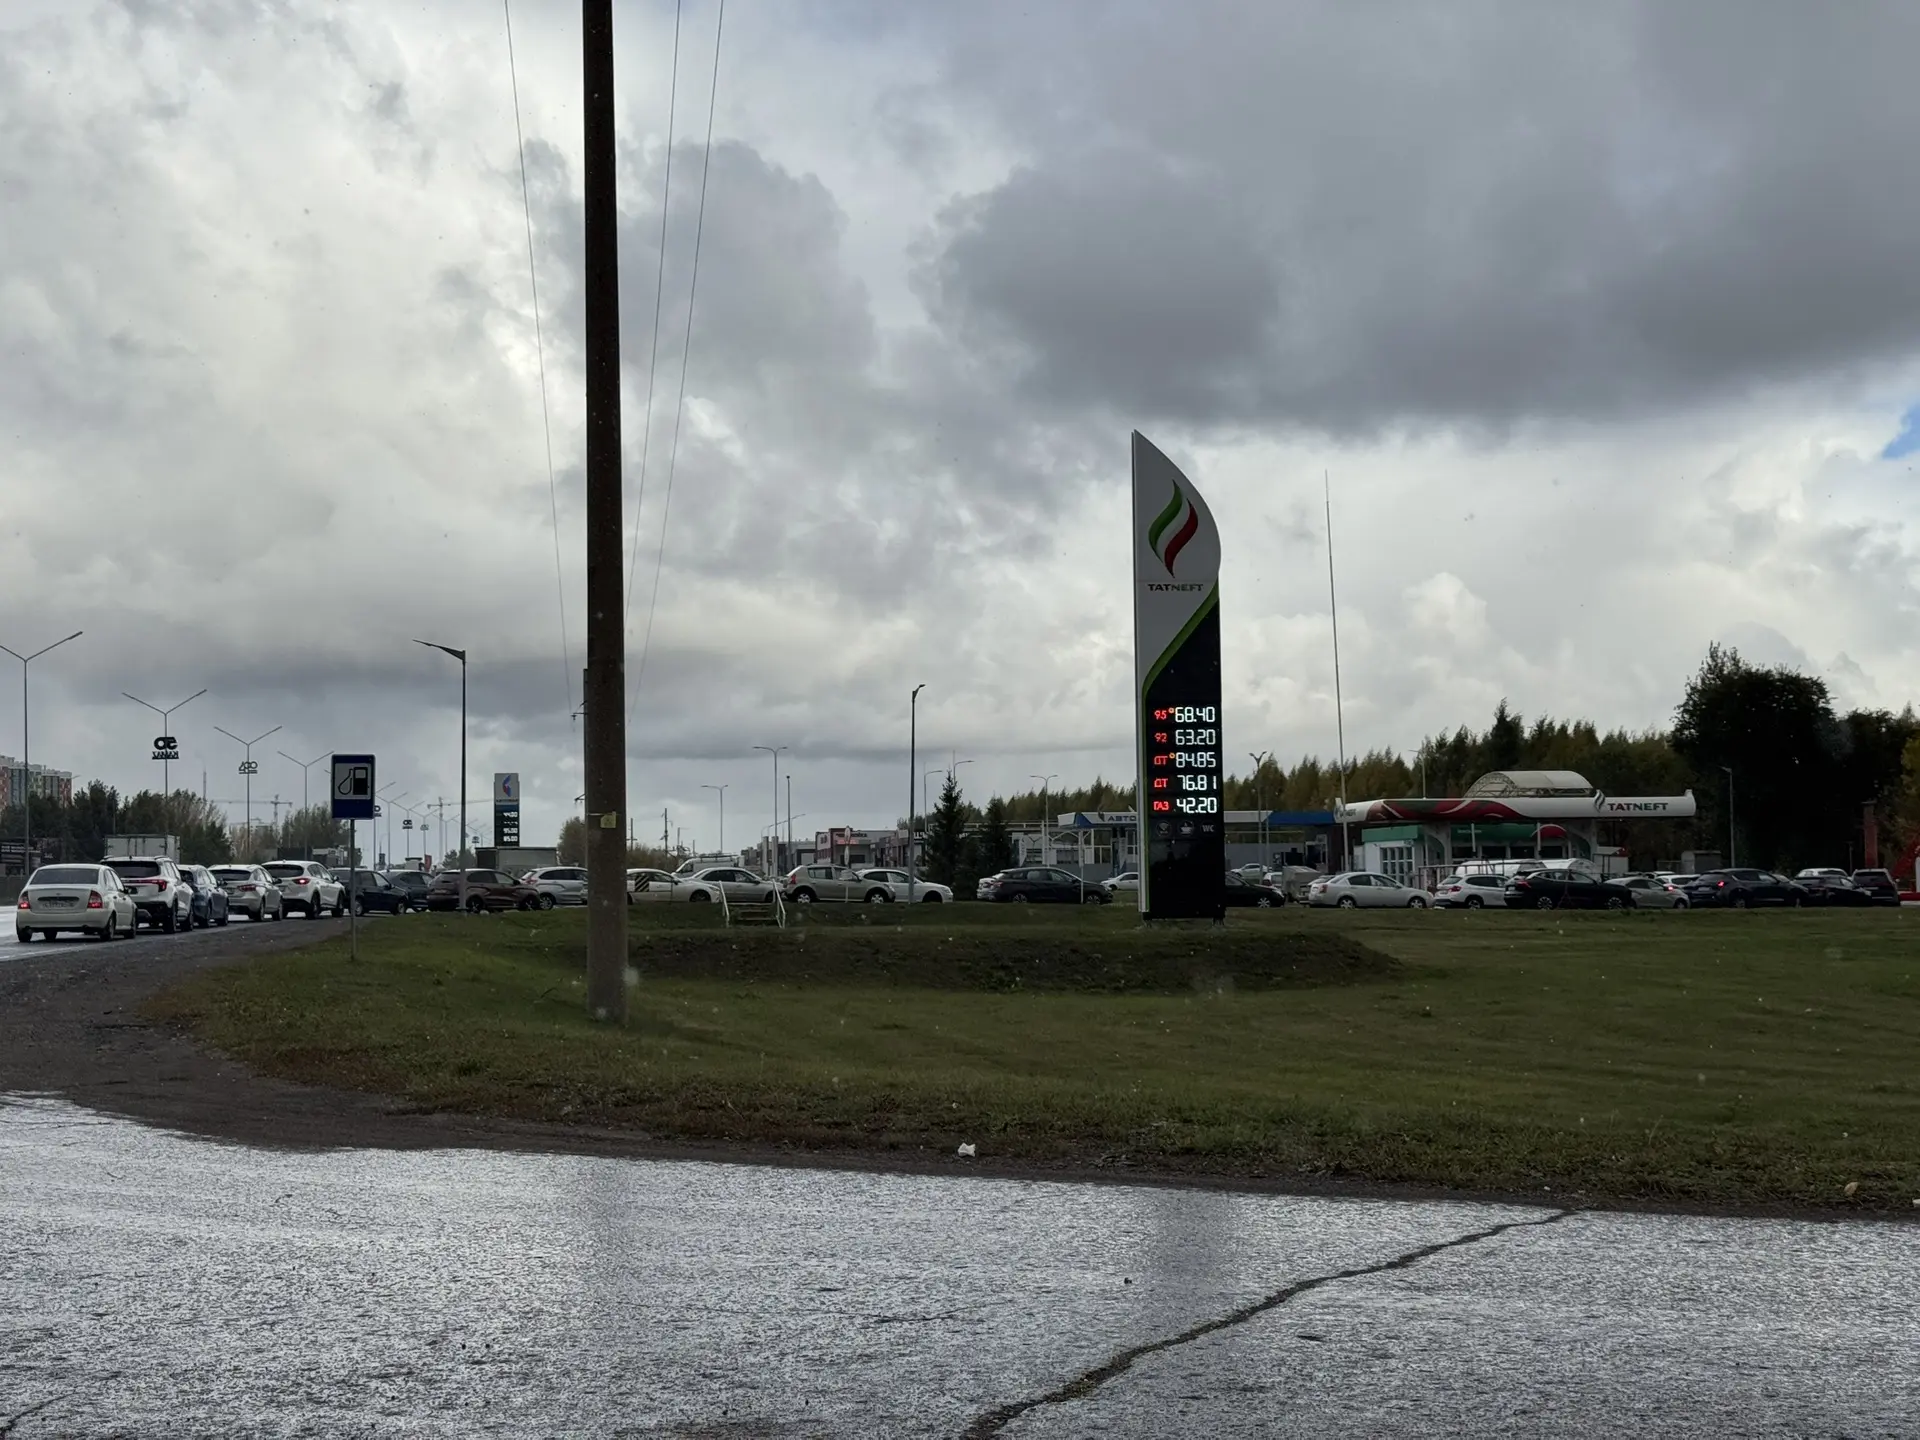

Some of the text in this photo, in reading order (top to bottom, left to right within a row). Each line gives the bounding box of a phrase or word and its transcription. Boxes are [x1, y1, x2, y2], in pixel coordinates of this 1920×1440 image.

[1147, 583, 1204, 592] TATNEFT
[1154, 706, 1216, 723] 95 68.40
[1154, 729, 1216, 746] 92 63.20
[1175, 751, 1217, 768] 84.85
[1153, 774, 1218, 791] ДТ 76.81
[1153, 797, 1218, 814] ГАЗ 42.20
[1607, 802, 1669, 811] TATNEFT
[1202, 824, 1215, 833] WC
